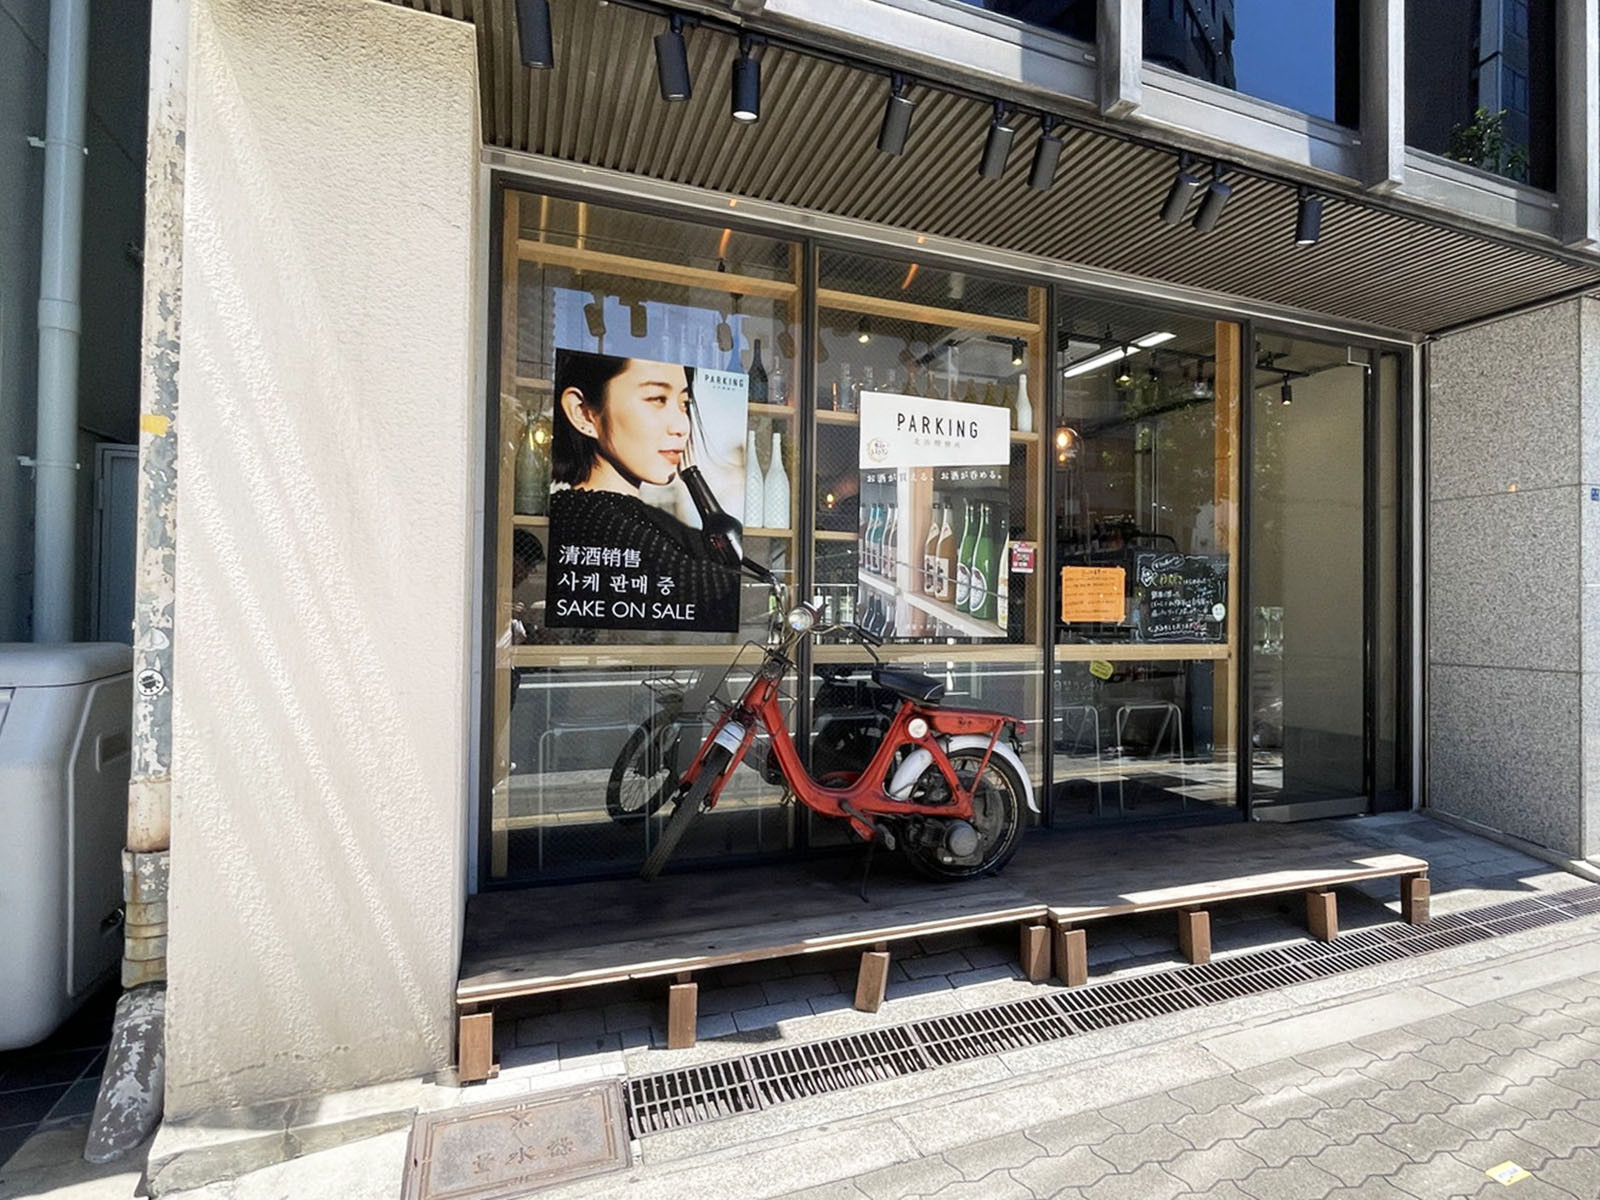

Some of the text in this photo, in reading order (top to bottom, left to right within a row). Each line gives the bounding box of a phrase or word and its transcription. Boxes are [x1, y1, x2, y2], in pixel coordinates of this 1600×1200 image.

[704, 374, 744, 388] PARKING
[897, 412, 979, 439] PARKING
[558, 544, 642, 568] 清酒销售
[557, 571, 676, 596] 사케 판매 중
[556, 599, 696, 620] SAKE ON SALE
